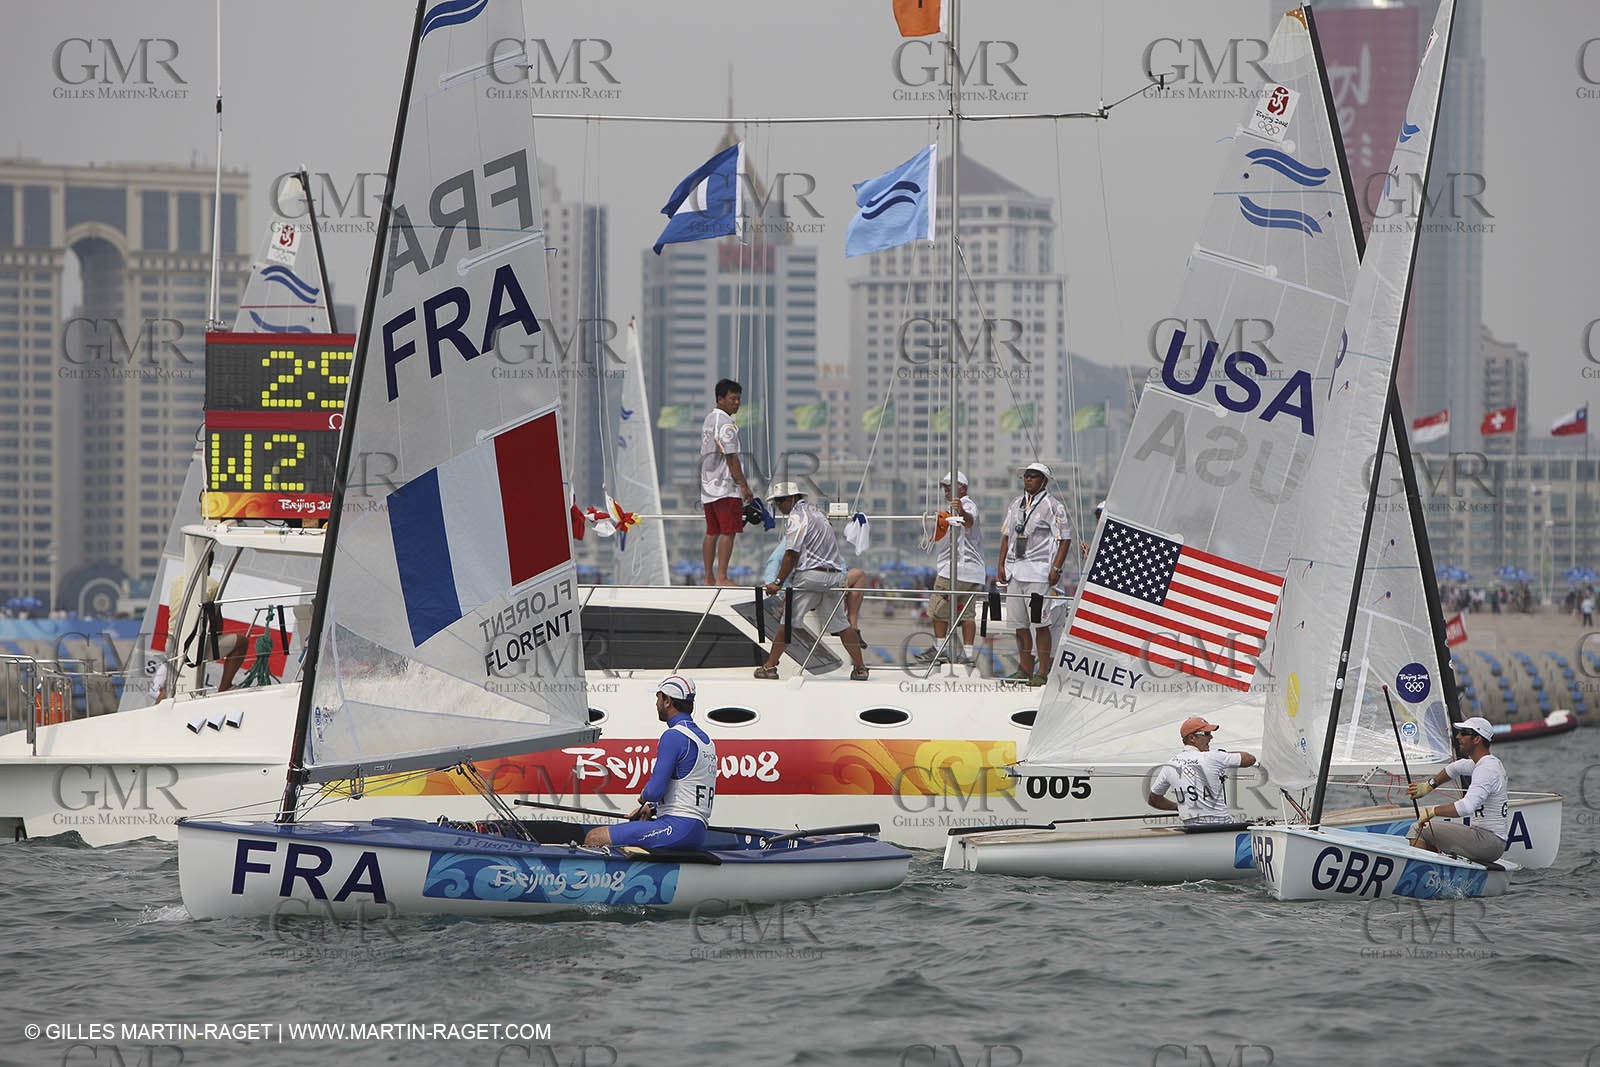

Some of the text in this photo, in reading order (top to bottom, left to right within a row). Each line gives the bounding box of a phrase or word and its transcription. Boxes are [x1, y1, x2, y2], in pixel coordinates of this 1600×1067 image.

[382, 264, 541, 402] FRA
[262, 350, 354, 409] 2:5
[1162, 329, 1315, 437] USA
[484, 610, 573, 677] FLORENT
[1058, 650, 1144, 690] RAILEY
[561, 745, 781, 789] Beiji 008
[1026, 775, 1092, 799] 005
[695, 785, 715, 809] FR
[1174, 785, 1215, 804] USA
[231, 838, 387, 904] FRA
[488, 863, 626, 895] Beijing 2008
[1311, 846, 1395, 899] GBR
